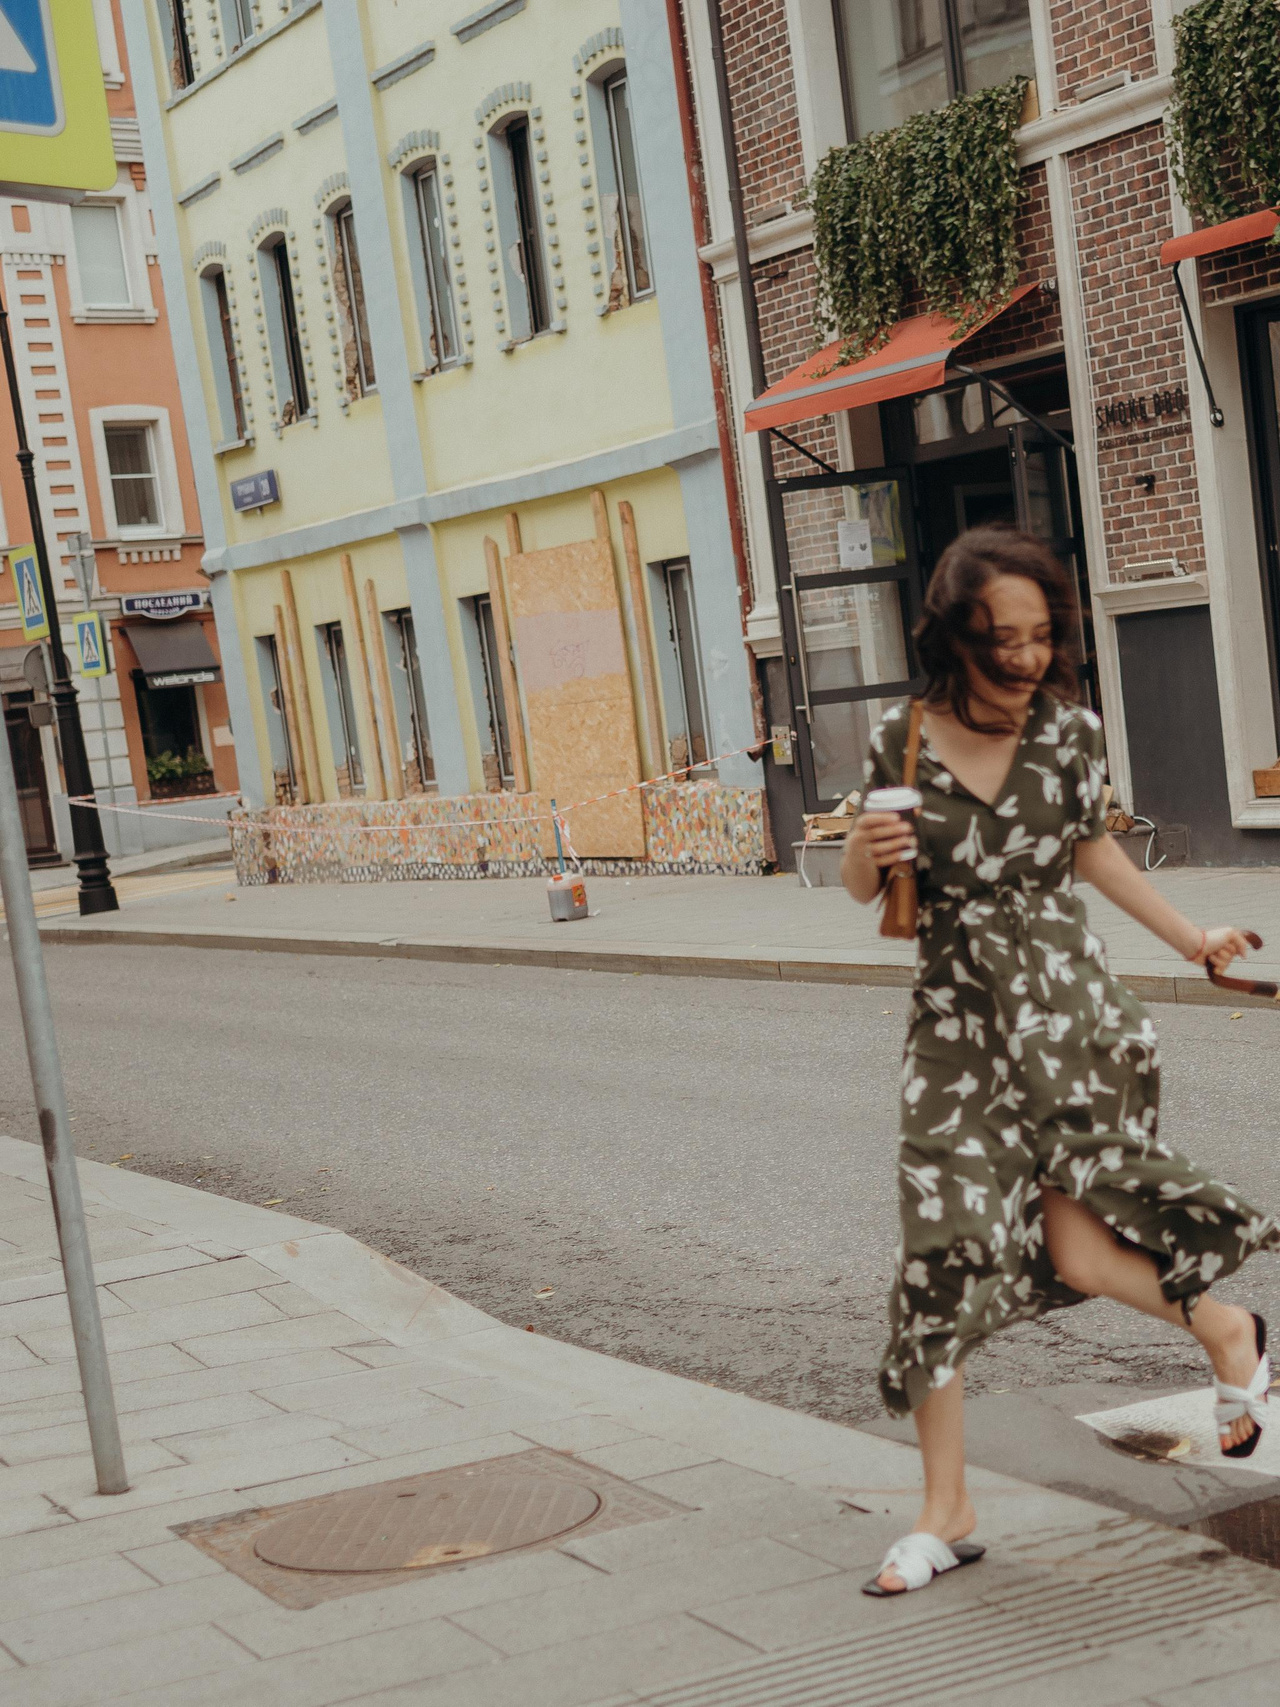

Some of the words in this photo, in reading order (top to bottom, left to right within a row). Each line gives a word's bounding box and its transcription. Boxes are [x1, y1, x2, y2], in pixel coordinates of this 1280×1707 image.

[1096, 396, 1148, 430] SMOKE
[1152, 386, 1186, 417] BBQ
[134, 595, 193, 610] ПОСЛЕДНИЙ
